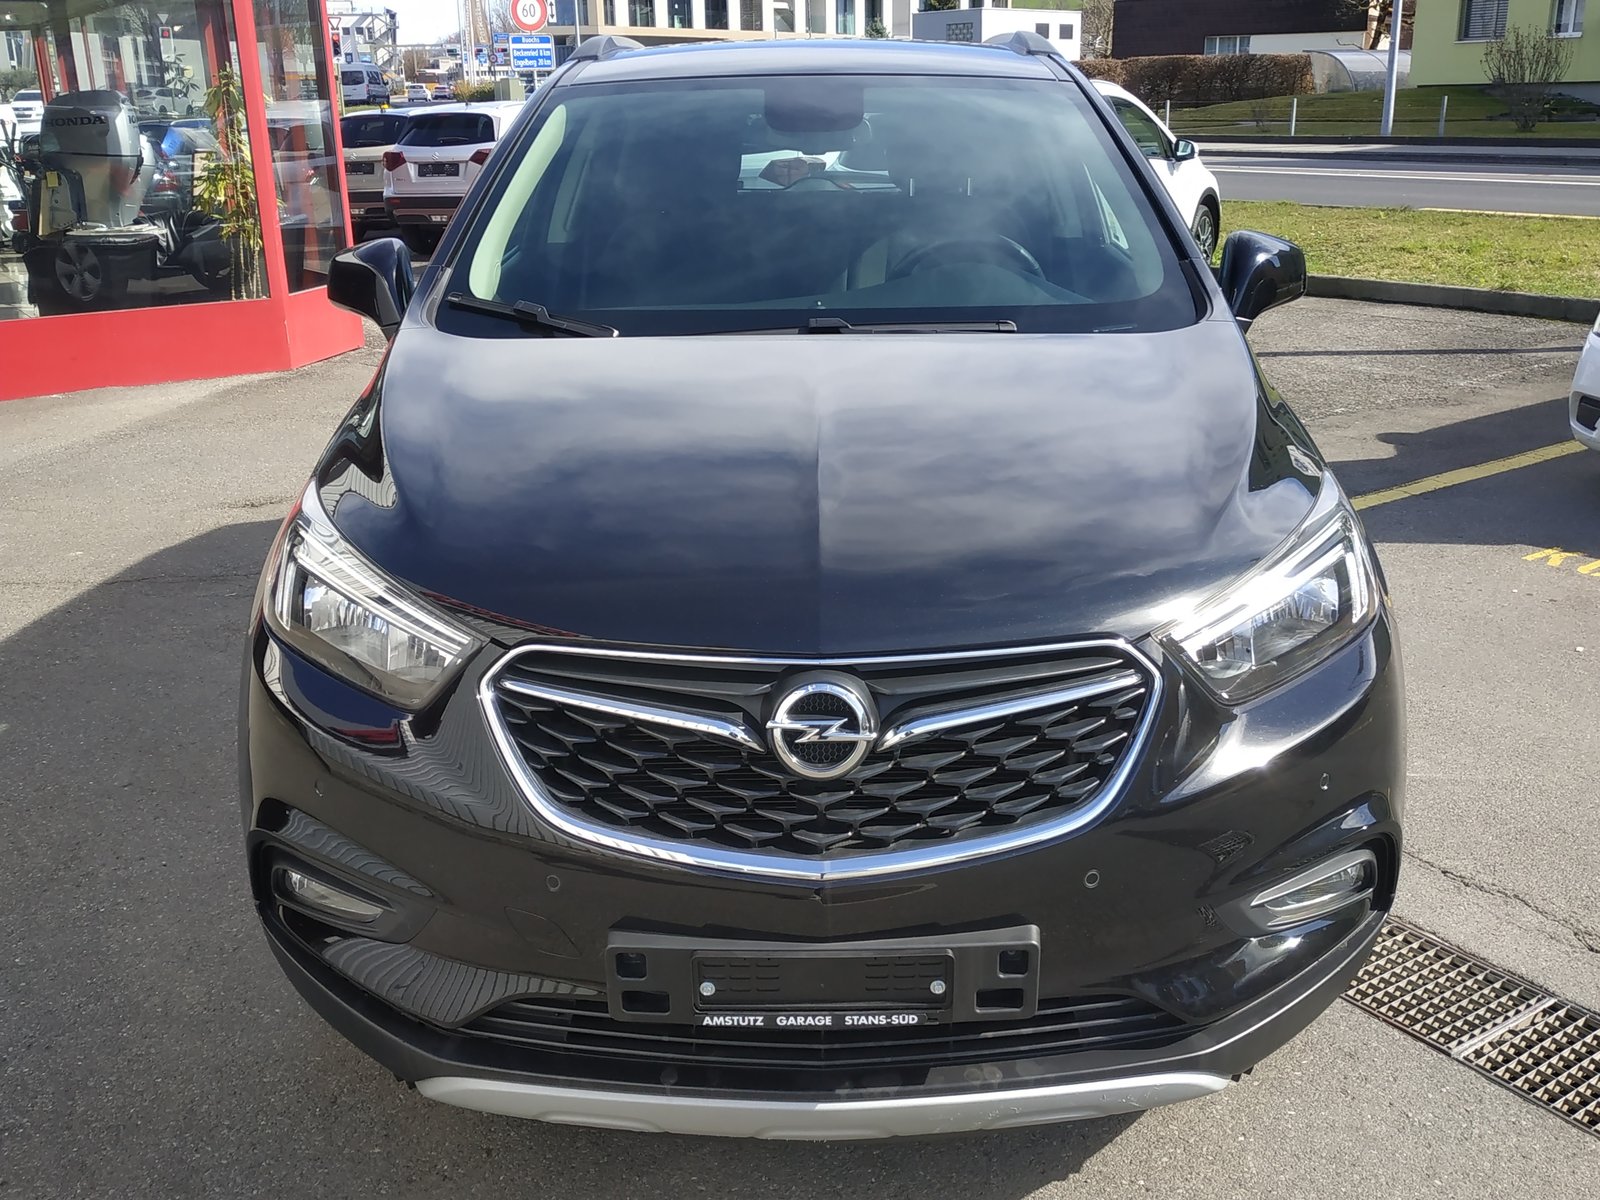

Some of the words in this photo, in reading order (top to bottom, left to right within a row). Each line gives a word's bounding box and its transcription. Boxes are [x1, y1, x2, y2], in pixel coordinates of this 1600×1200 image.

[522, 3, 536, 17] 60
[514, 58, 537, 68] Engelberg
[45, 116, 106, 127] HONDA
[702, 1016, 764, 1026] AMSTUTZ
[776, 1015, 832, 1026] GARAGE
[844, 1014, 919, 1025] STANS-SÜD
